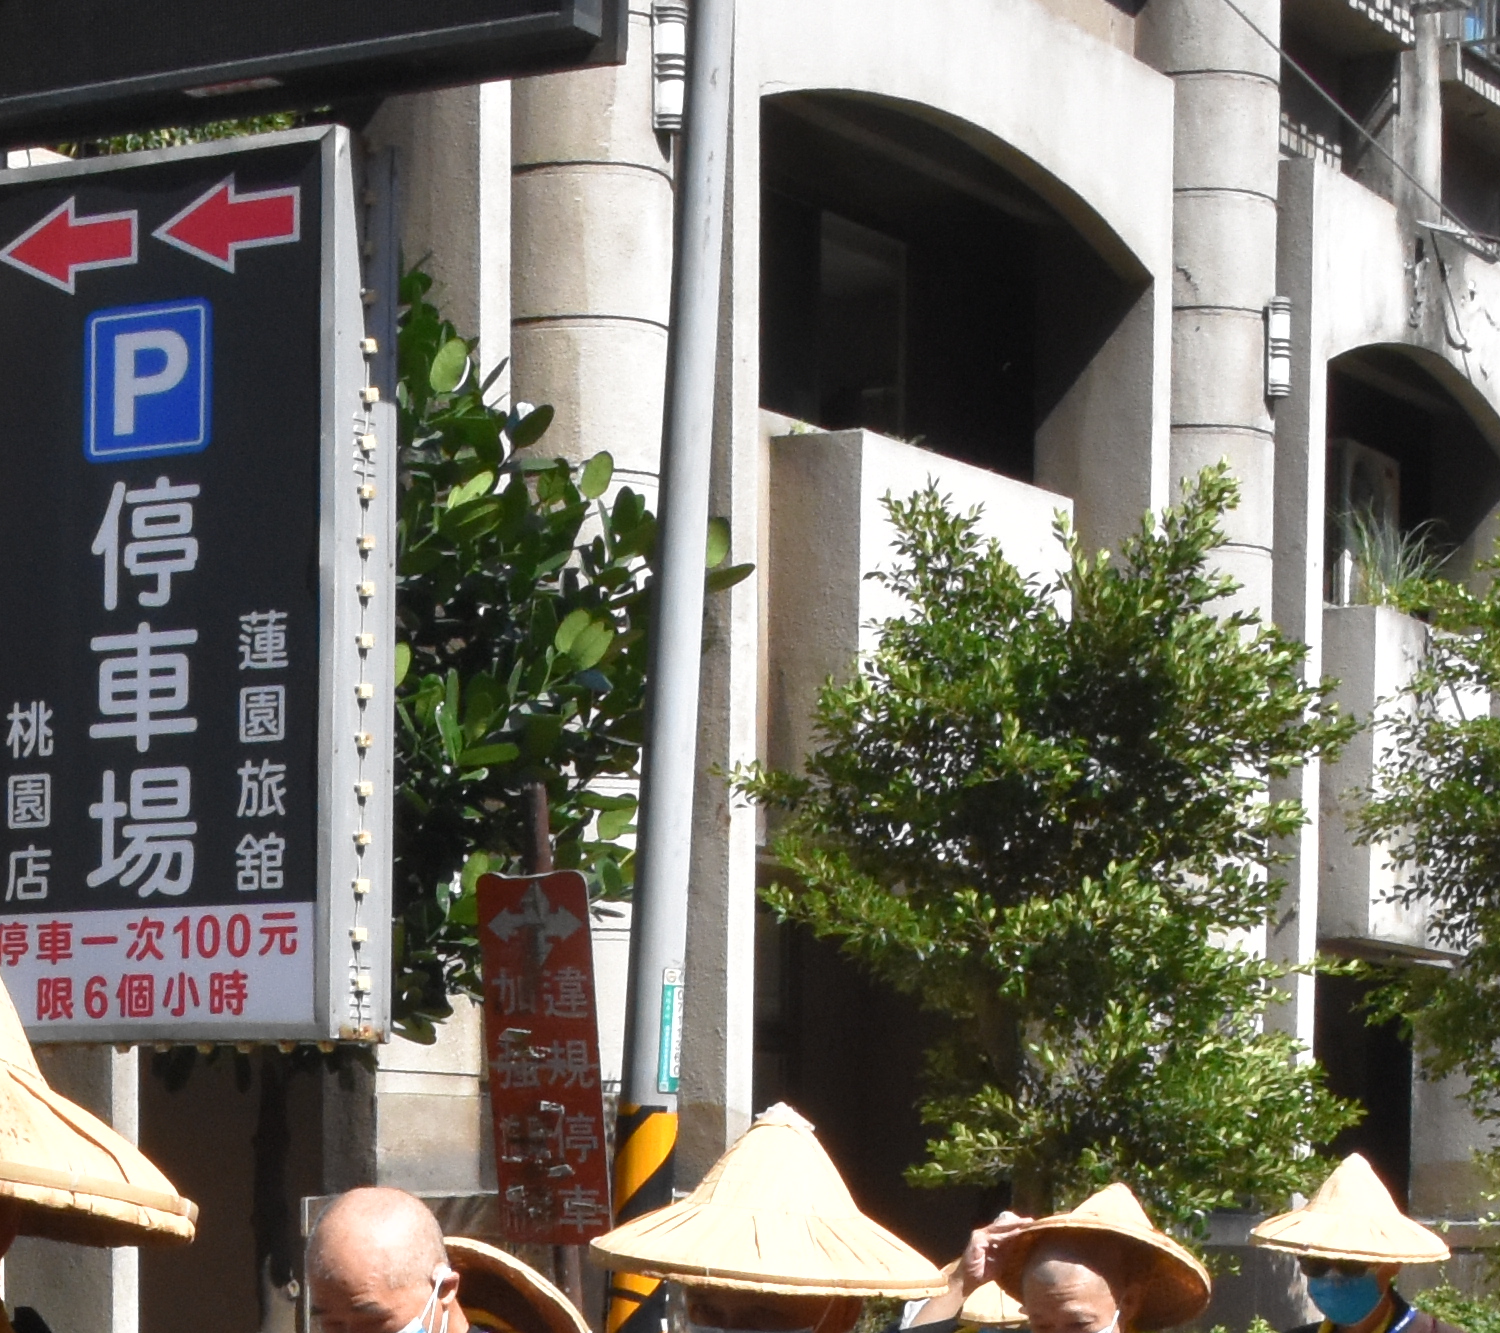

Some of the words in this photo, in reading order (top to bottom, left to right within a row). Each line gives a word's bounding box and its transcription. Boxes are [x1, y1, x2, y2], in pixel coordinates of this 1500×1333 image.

[112, 329, 190, 438] P
[86, 475, 201, 899] 停車場
[4, 699, 55, 903] 桃園店
[36, 969, 249, 1020] 限6個小時
[544, 966, 604, 1234] 違規停車
